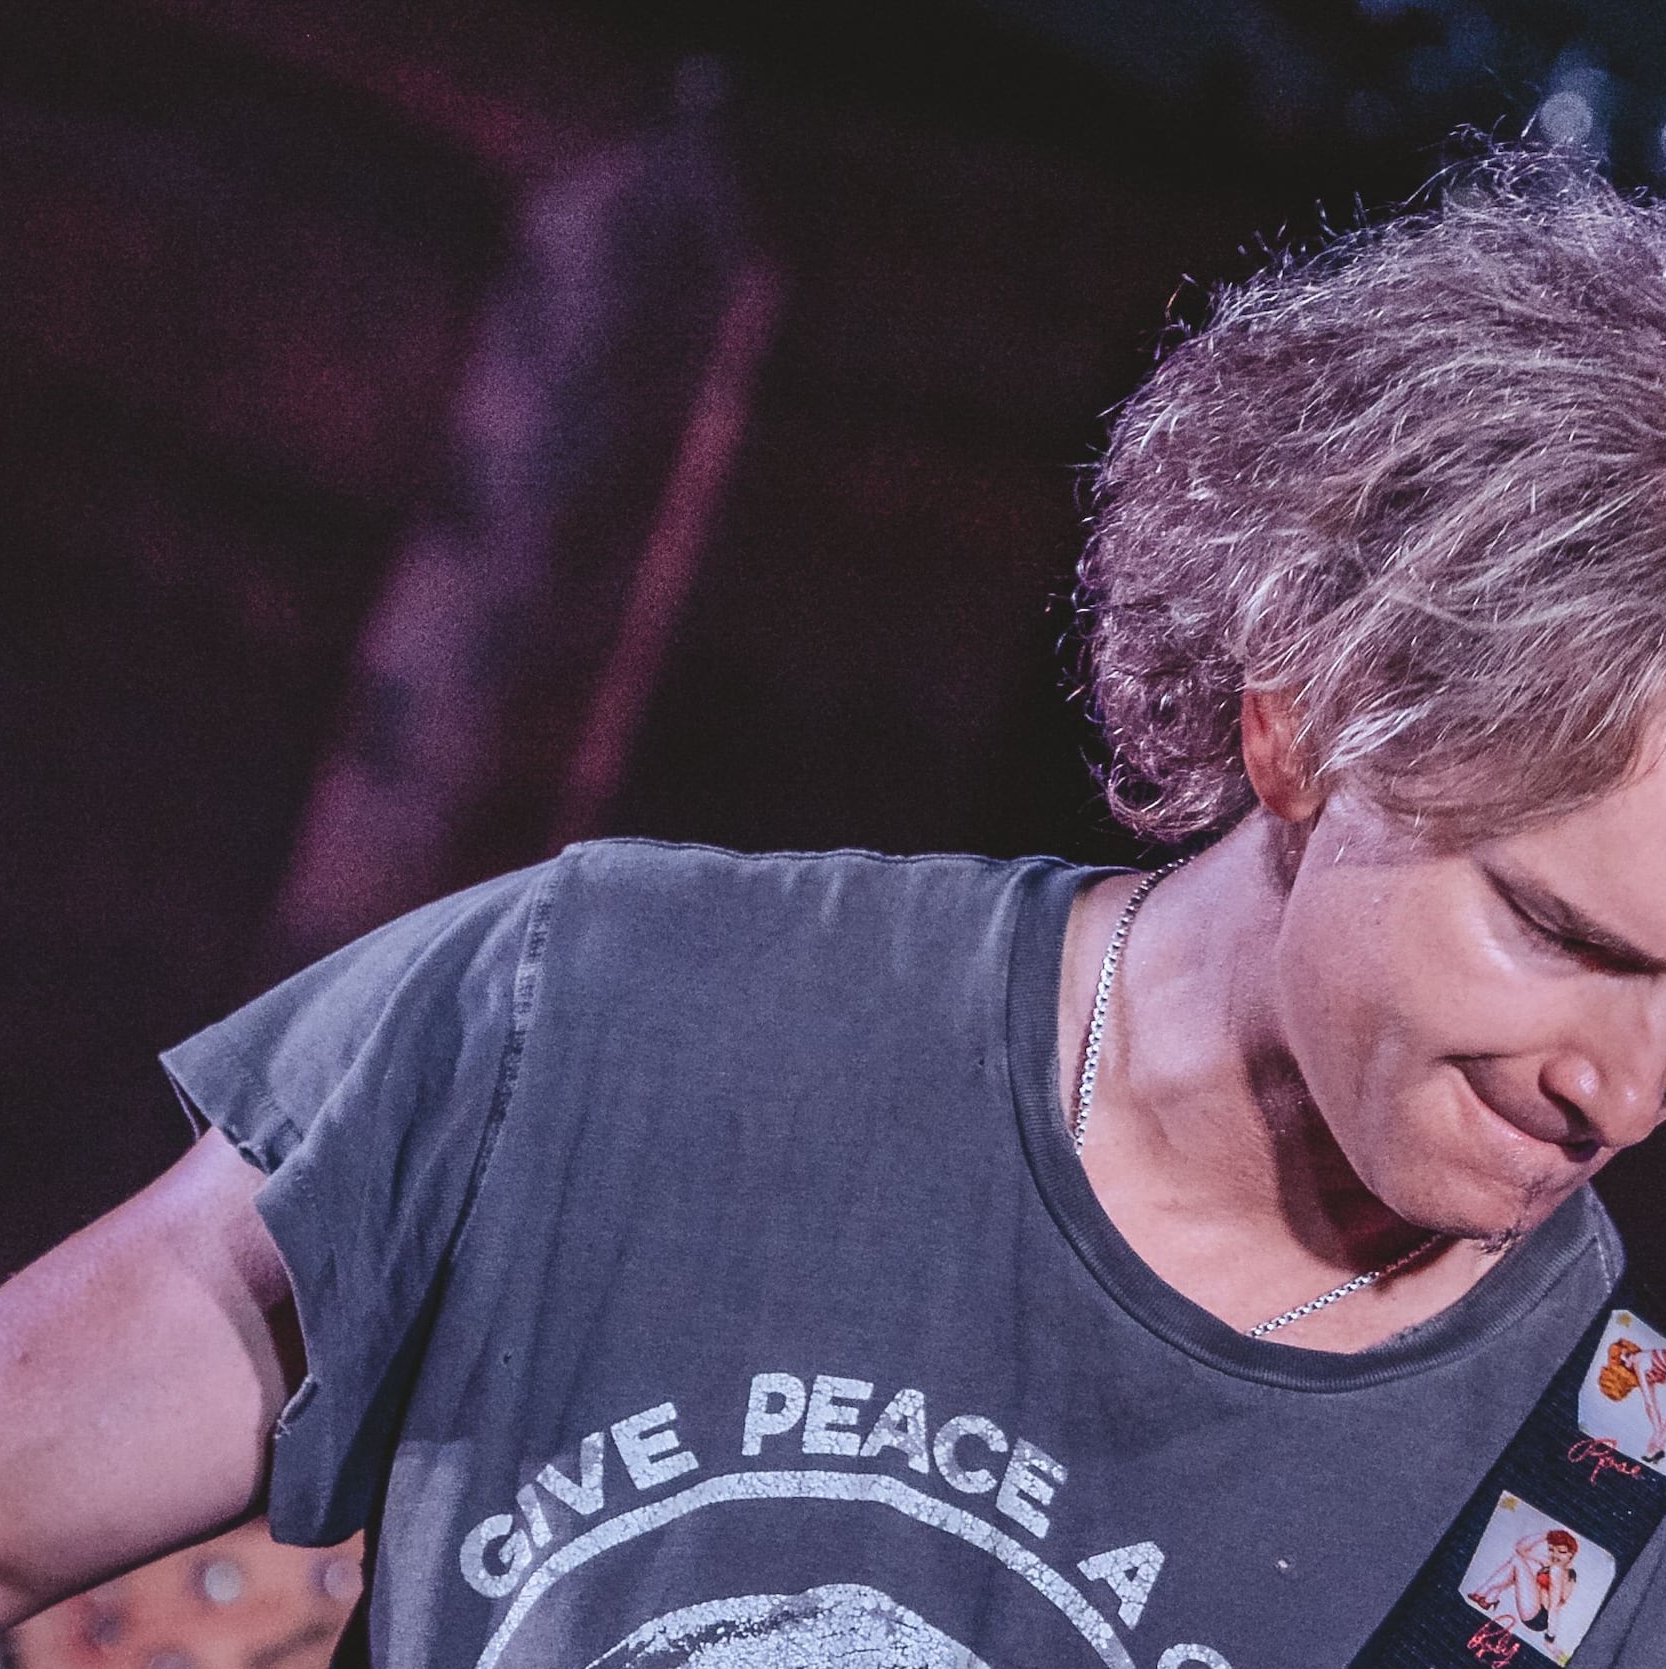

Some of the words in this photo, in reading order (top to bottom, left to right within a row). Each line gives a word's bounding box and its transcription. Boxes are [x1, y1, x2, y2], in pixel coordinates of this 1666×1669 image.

[459, 1401, 699, 1598] GIVE
[741, 1372, 1069, 1540] PEACE
[1077, 1540, 1165, 1630] A
